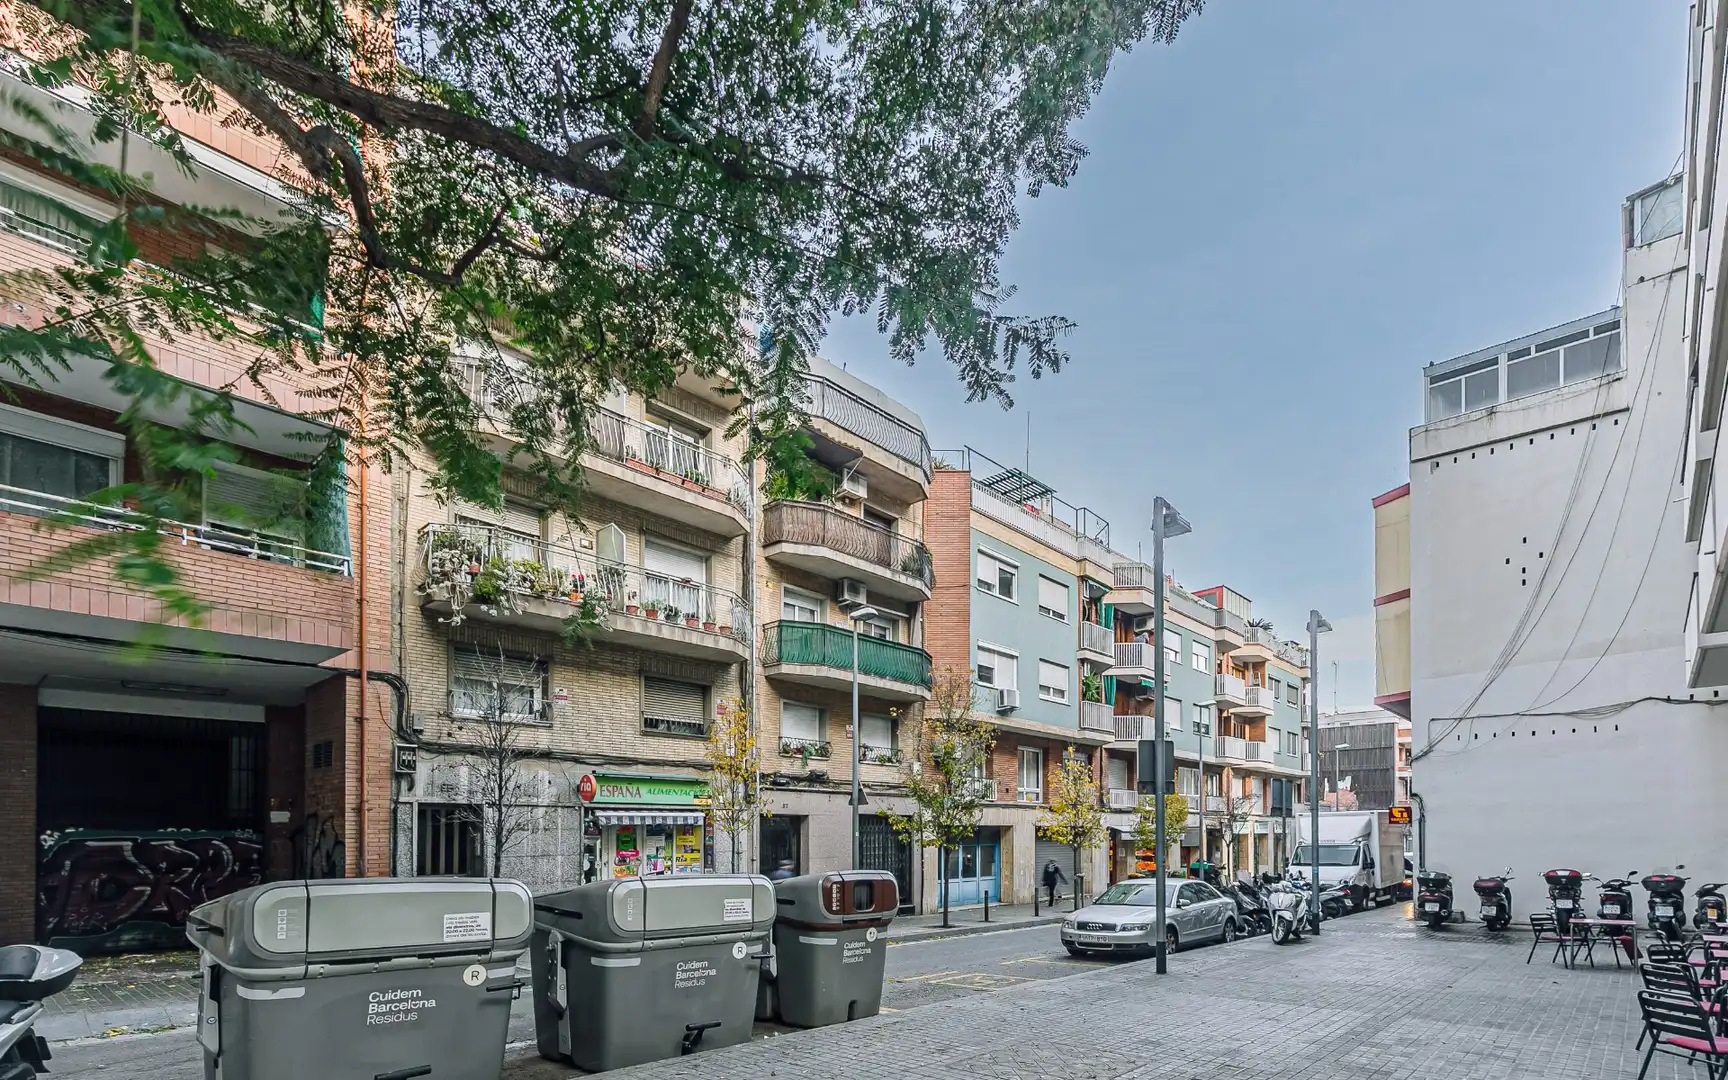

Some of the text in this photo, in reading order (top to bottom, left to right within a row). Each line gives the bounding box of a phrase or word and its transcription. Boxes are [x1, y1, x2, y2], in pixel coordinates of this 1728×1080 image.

[599, 783, 642, 799] ESPAÑA
[737, 946, 744, 955] R
[676, 960, 708, 971] Cuidem
[471, 970, 480, 980] R
[675, 968, 717, 980] Barcelona
[674, 978, 706, 989] Residus
[368, 988, 422, 1003] Cuidem
[368, 999, 437, 1014] Barcelona
[366, 1011, 418, 1026] Residus
